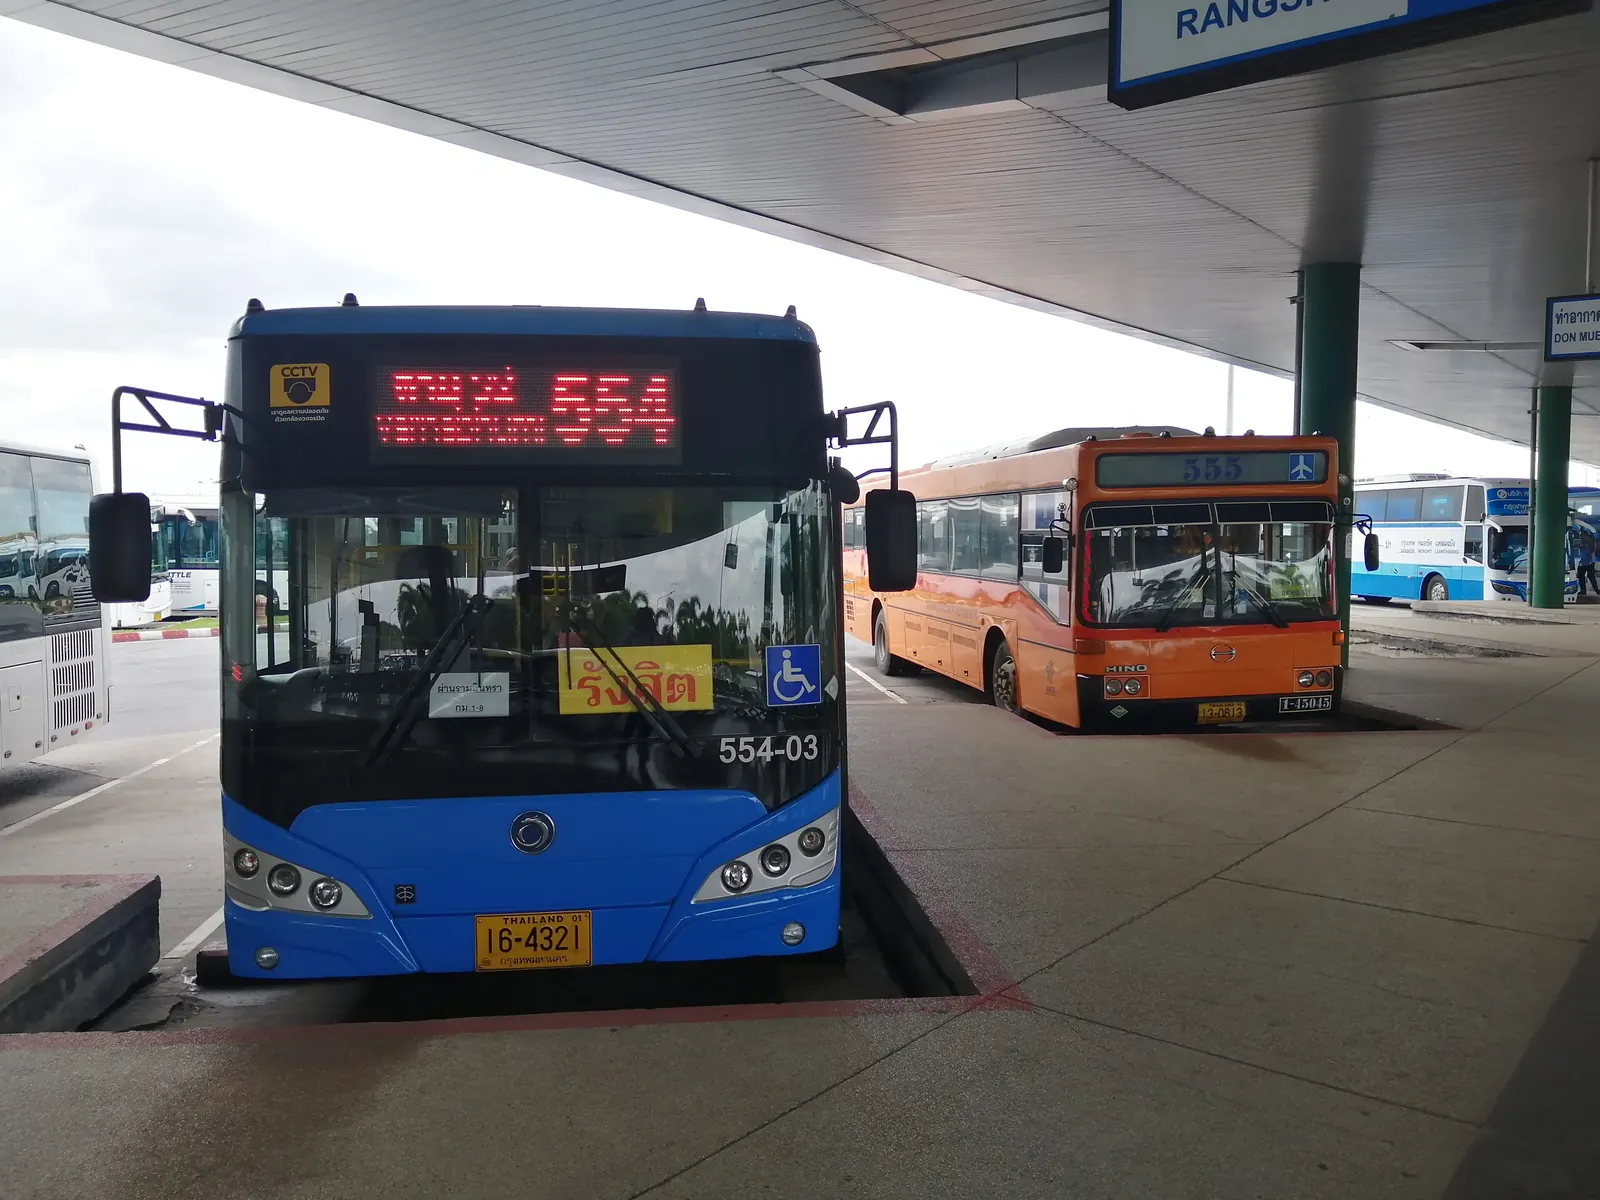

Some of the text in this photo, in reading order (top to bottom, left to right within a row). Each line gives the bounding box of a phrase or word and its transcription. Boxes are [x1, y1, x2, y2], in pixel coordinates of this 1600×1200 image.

[1176, 0, 1330, 39] RANG
[1554, 330, 1600, 343] DON MUE
[280, 365, 319, 378] CCTV
[552, 373, 675, 445] 554
[1183, 456, 1243, 481] 555
[1105, 664, 1149, 673] HINO
[576, 660, 697, 707] รังสิต
[1282, 697, 1330, 710] 1-45045
[719, 734, 819, 764] 554-03
[503, 914, 564, 925] THAILAND
[488, 924, 580, 954] 16-4321
[500, 955, 568, 968] กรุงเทพมหานคร
